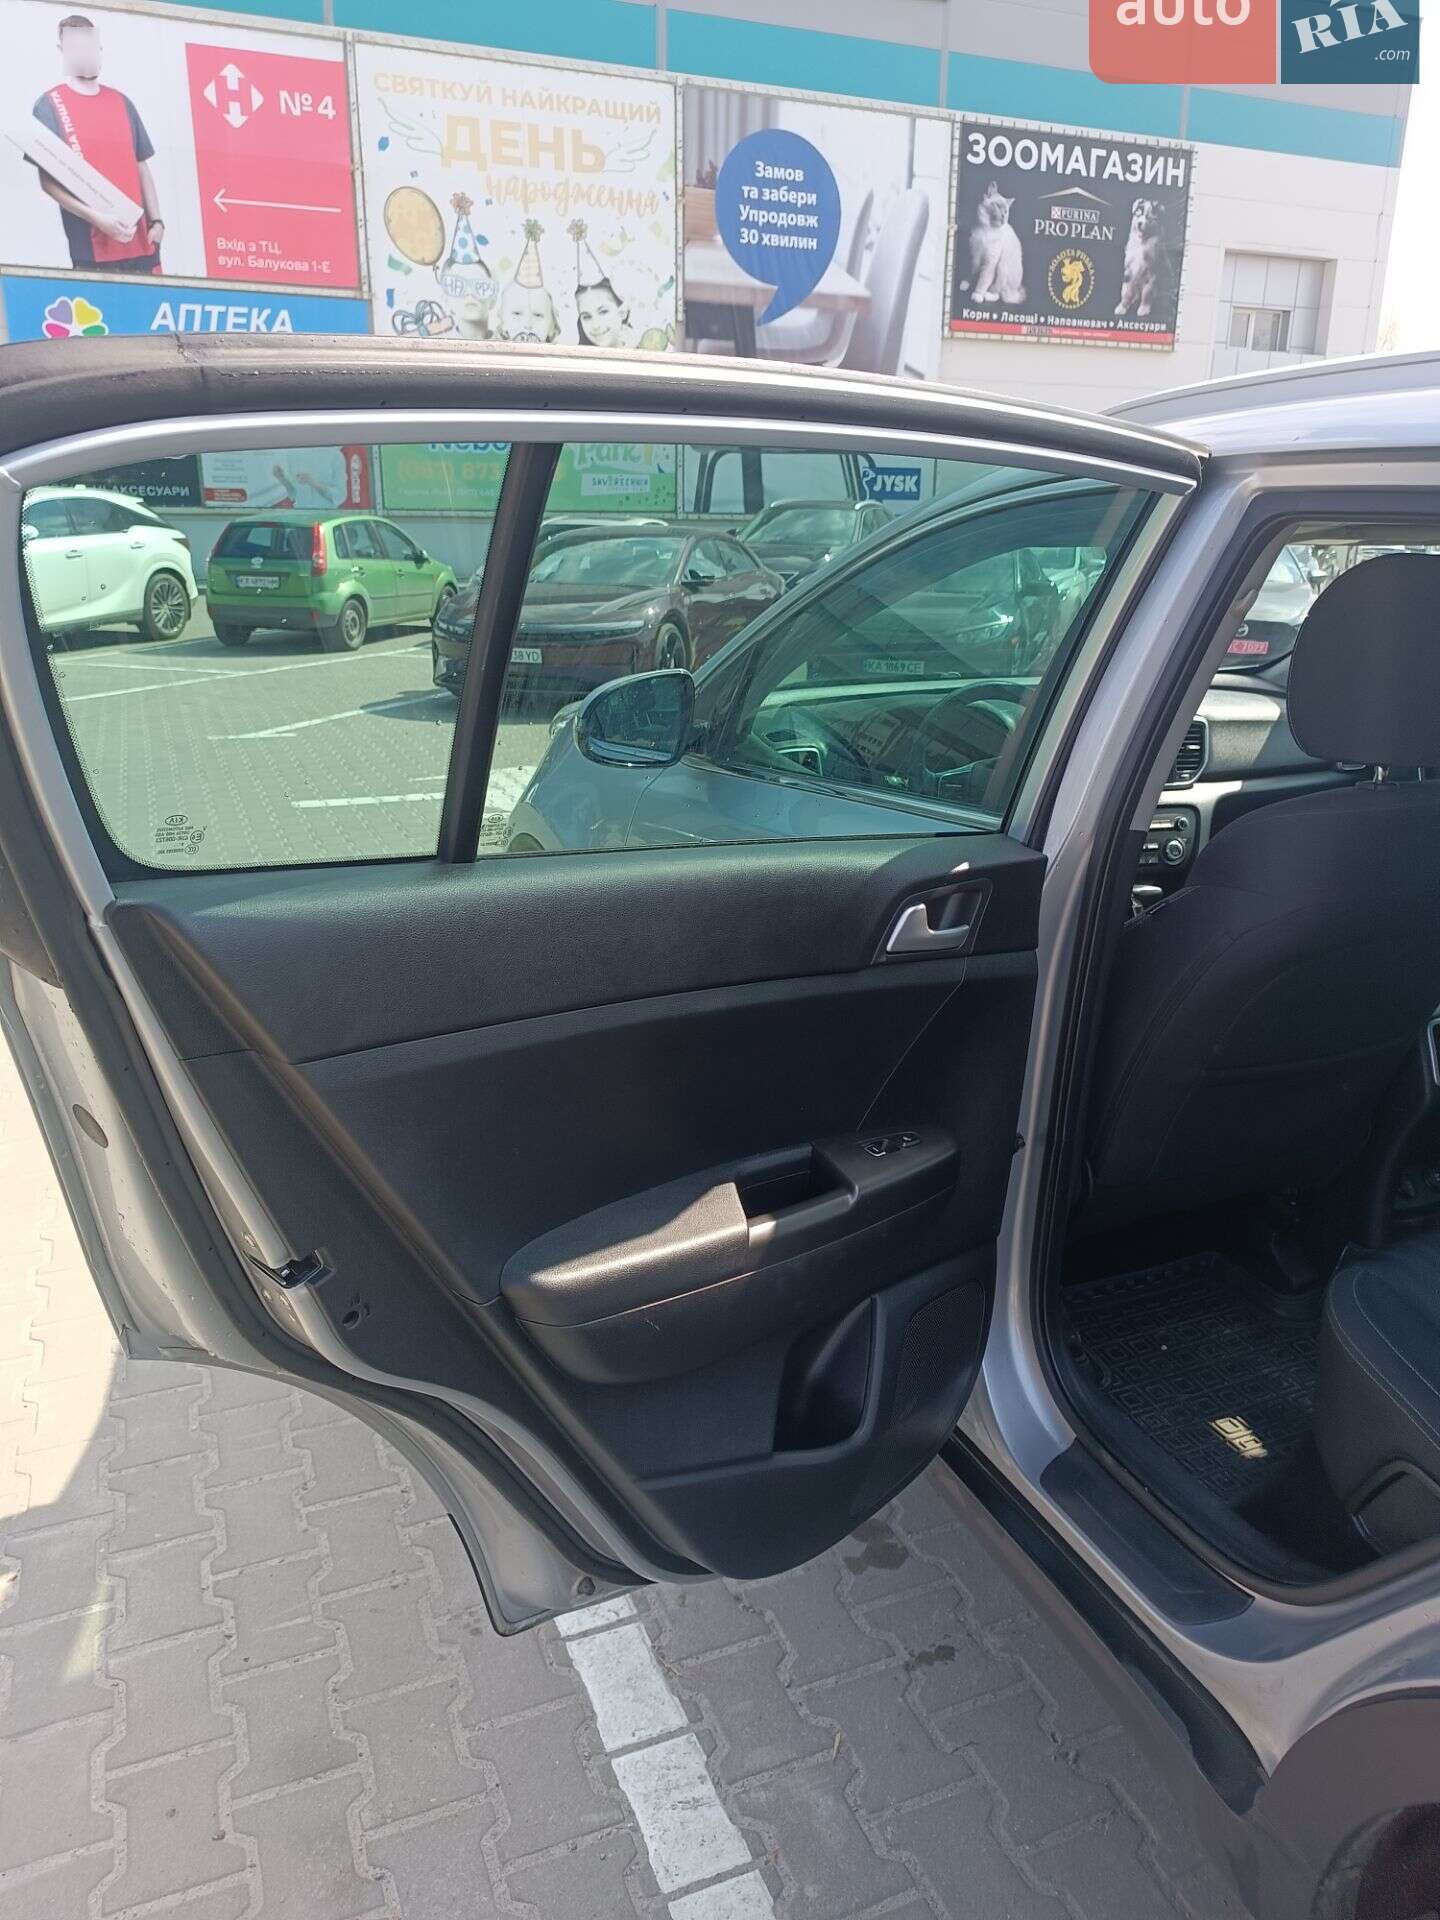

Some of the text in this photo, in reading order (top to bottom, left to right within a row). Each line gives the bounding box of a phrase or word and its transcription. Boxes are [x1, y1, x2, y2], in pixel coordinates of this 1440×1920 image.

[373, 71, 661, 124] СВЯТКУЙ НАЙКРАЩИЙ
[441, 113, 606, 174] ДЕНЬ
[966, 132, 1186, 188] ЗООМАГАЗИН
[755, 161, 804, 182] Замов
[742, 185, 817, 207] та забери
[739, 204, 818, 228] Упродовж
[739, 228, 817, 250] 30 хвилин
[1035, 218, 1114, 241] PRO PLAN
[216, 237, 246, 253] Вхід
[248, 242, 256, 252] з
[218, 255, 245, 268] вул.
[151, 302, 294, 333] АПТЕКА
[962, 308, 990, 323] Корм
[1000, 312, 1038, 325] Ласощі
[1047, 315, 1108, 329] Наповнювач
[1117, 319, 1167, 332] Аксесуари
[112, 485, 190, 497] АКСЕСУАРИ
[873, 475, 918, 492] JYSK
